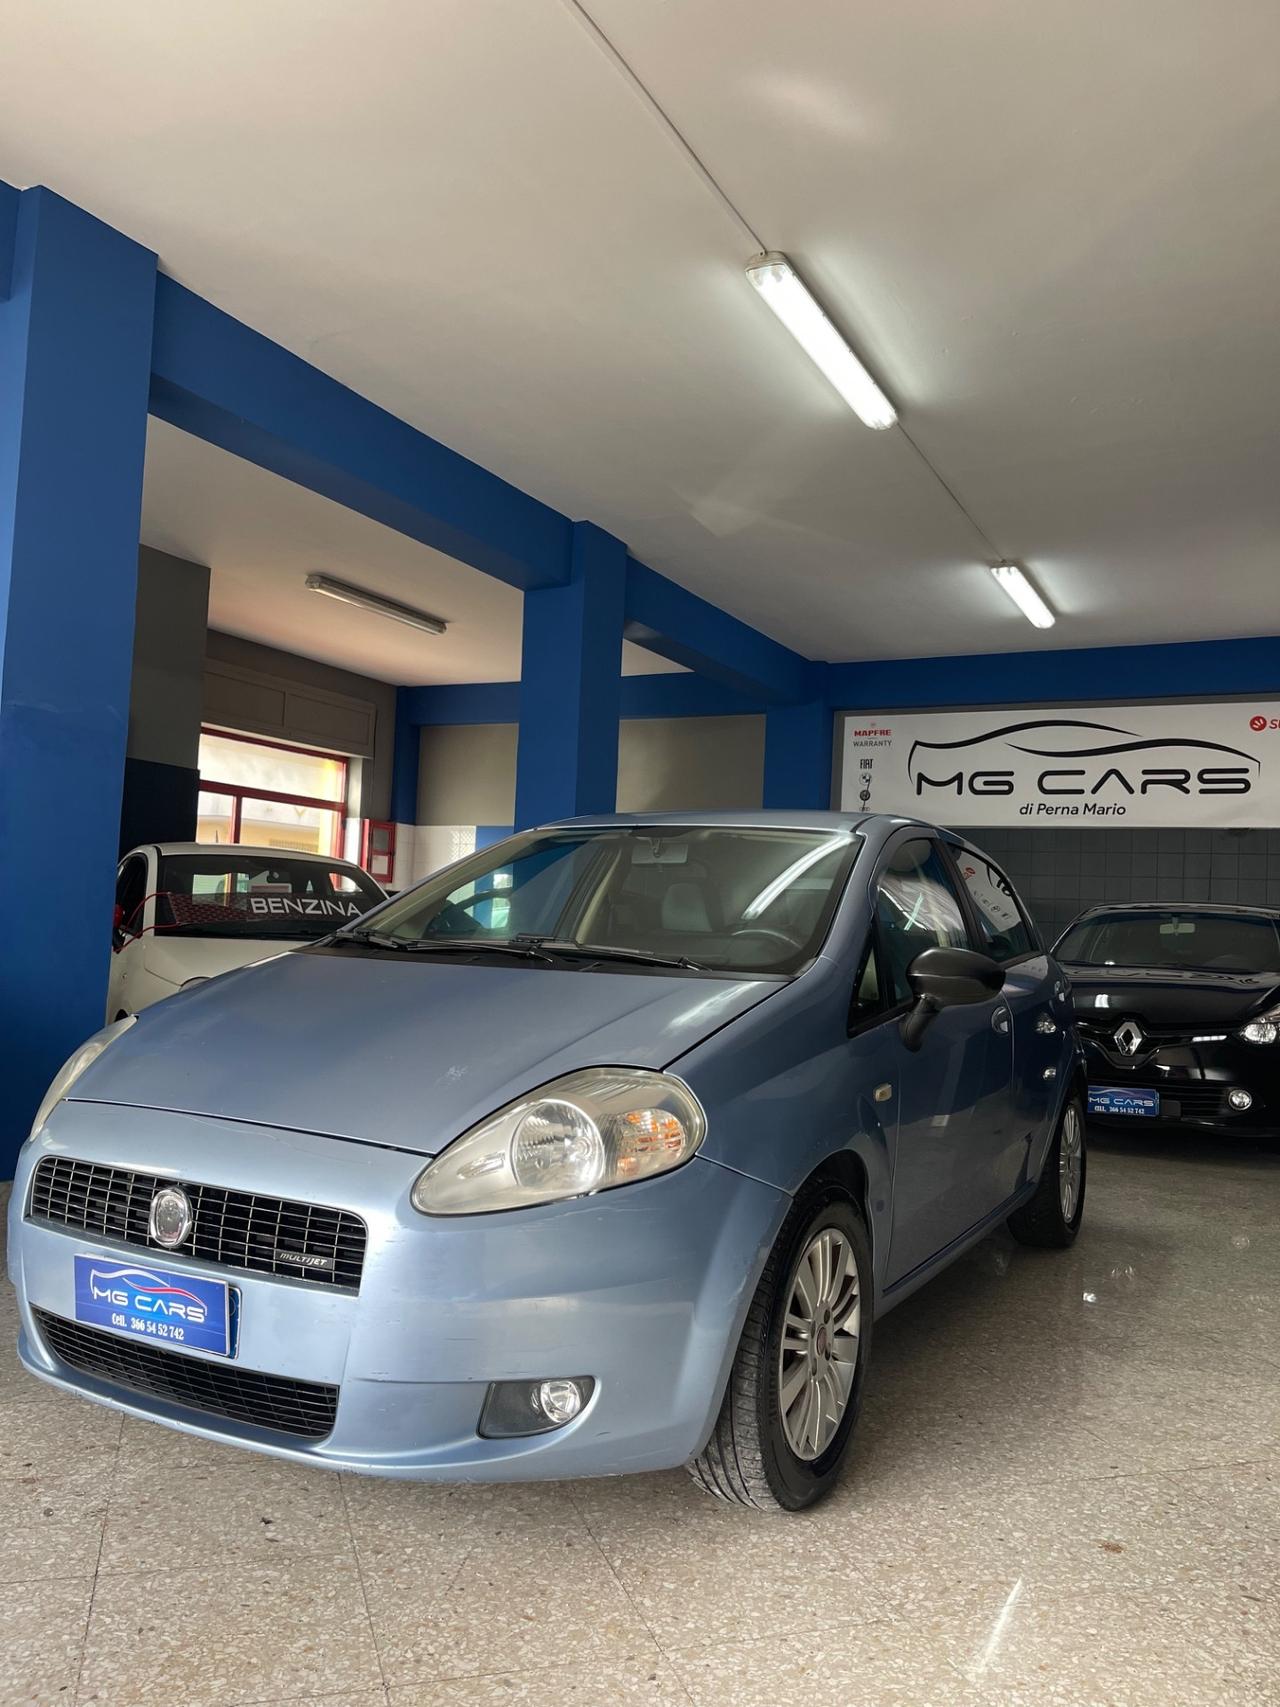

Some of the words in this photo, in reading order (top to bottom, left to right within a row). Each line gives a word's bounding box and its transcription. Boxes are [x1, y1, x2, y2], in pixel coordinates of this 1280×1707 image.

[854, 729, 892, 737] MAPFRE
[853, 740, 892, 748] WARRANTY
[860, 758, 873, 769] FIAT
[916, 770, 1014, 796] MG
[1037, 768, 1251, 795] CARS
[1019, 803, 1034, 815] di
[1036, 803, 1079, 815] Perna
[1082, 803, 1126, 815] Mario
[250, 897, 363, 917] BENZINA
[1113, 1098, 1154, 1107] CARS
[280, 1252, 328, 1265] MULTIJET
[93, 1286, 128, 1306] MG
[135, 1295, 205, 1323] CARS
[111, 1312, 127, 1327] Cell.
[130, 1317, 146, 1332] 366
[146, 1320, 157, 1334] 54
[157, 1323, 168, 1337] 52
[169, 1325, 184, 1340] 742
